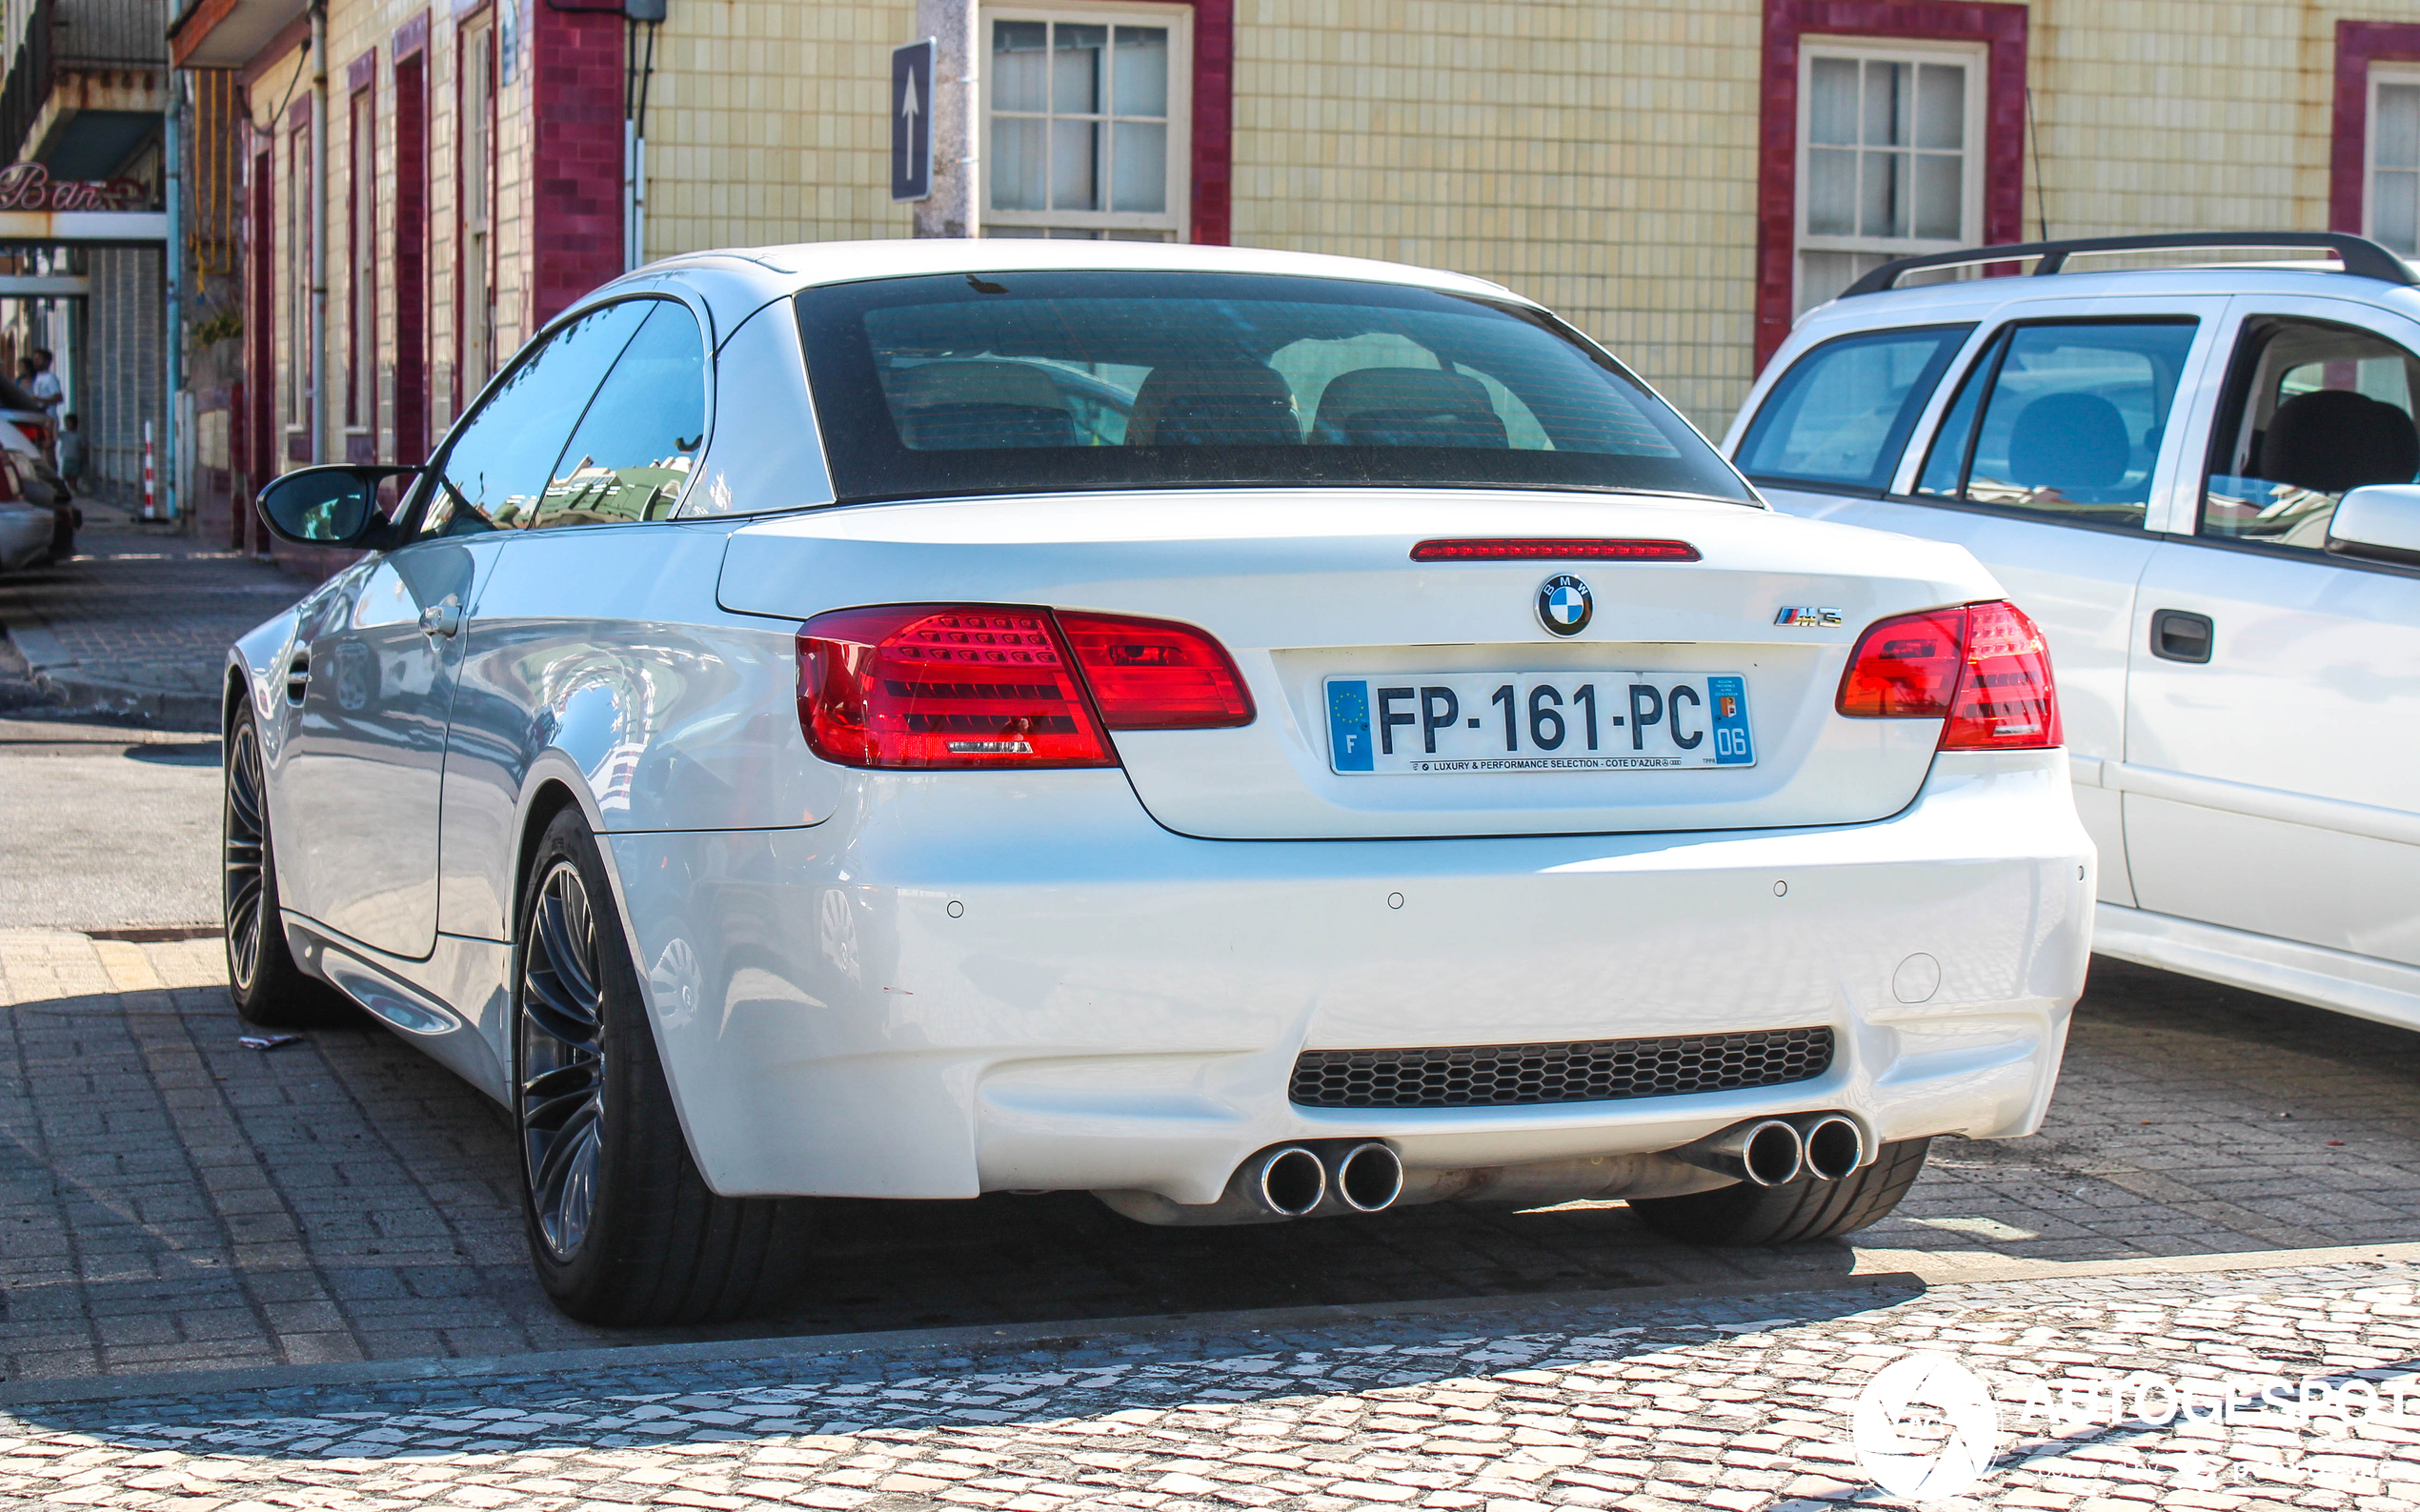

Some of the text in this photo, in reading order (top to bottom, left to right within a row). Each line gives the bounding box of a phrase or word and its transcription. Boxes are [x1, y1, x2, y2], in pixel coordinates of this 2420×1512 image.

[0, 160, 103, 210] Bar
[1543, 576, 1588, 595] BMW
[1774, 606, 1842, 628] M3
[1377, 684, 1704, 755] FP-161-PC
[1345, 734, 1358, 755] F
[1717, 728, 1746, 756] 06
[1434, 762, 1470, 771] LUXURY
[1471, 761, 1479, 770] &
[1481, 760, 1548, 770] PERFORMANCE
[1550, 759, 1599, 768] SELECTION
[1605, 759, 1629, 768] COTE
[1630, 758, 1662, 768] D'AZUR
